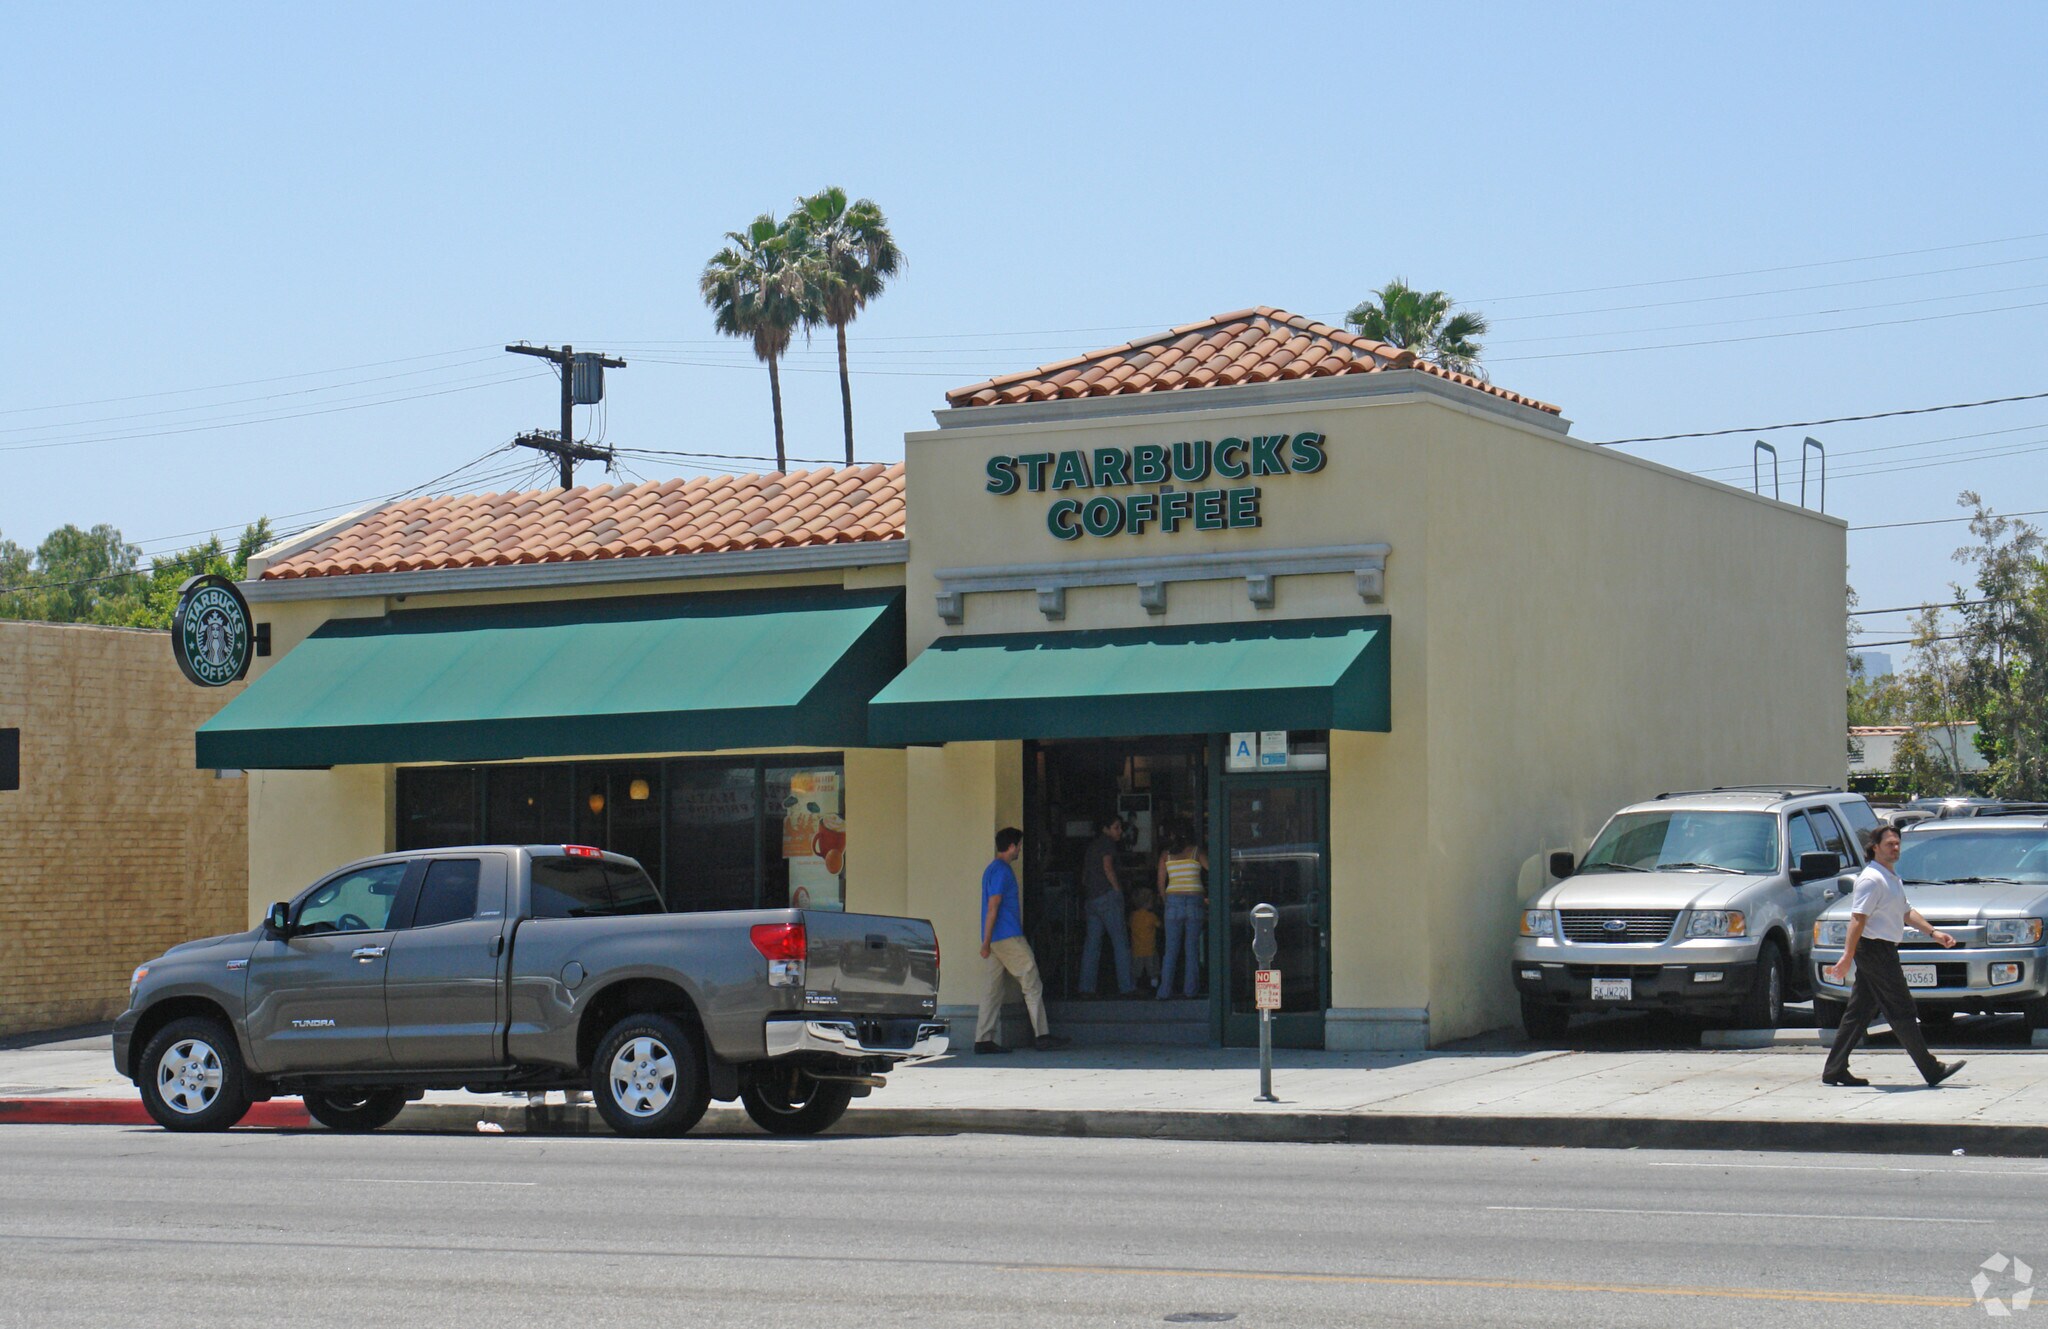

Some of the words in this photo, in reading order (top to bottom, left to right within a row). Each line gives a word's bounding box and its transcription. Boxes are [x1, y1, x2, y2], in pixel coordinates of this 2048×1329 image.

[985, 431, 1327, 495] STARBUCKS
[1047, 486, 1262, 540] COFFEE
[187, 592, 243, 634] STARBUCKS
[194, 655, 238, 680] COFFEE
[1236, 740, 1251, 757] A
[1257, 972, 1270, 982] NO
[291, 1019, 336, 1027] TUNDRA
